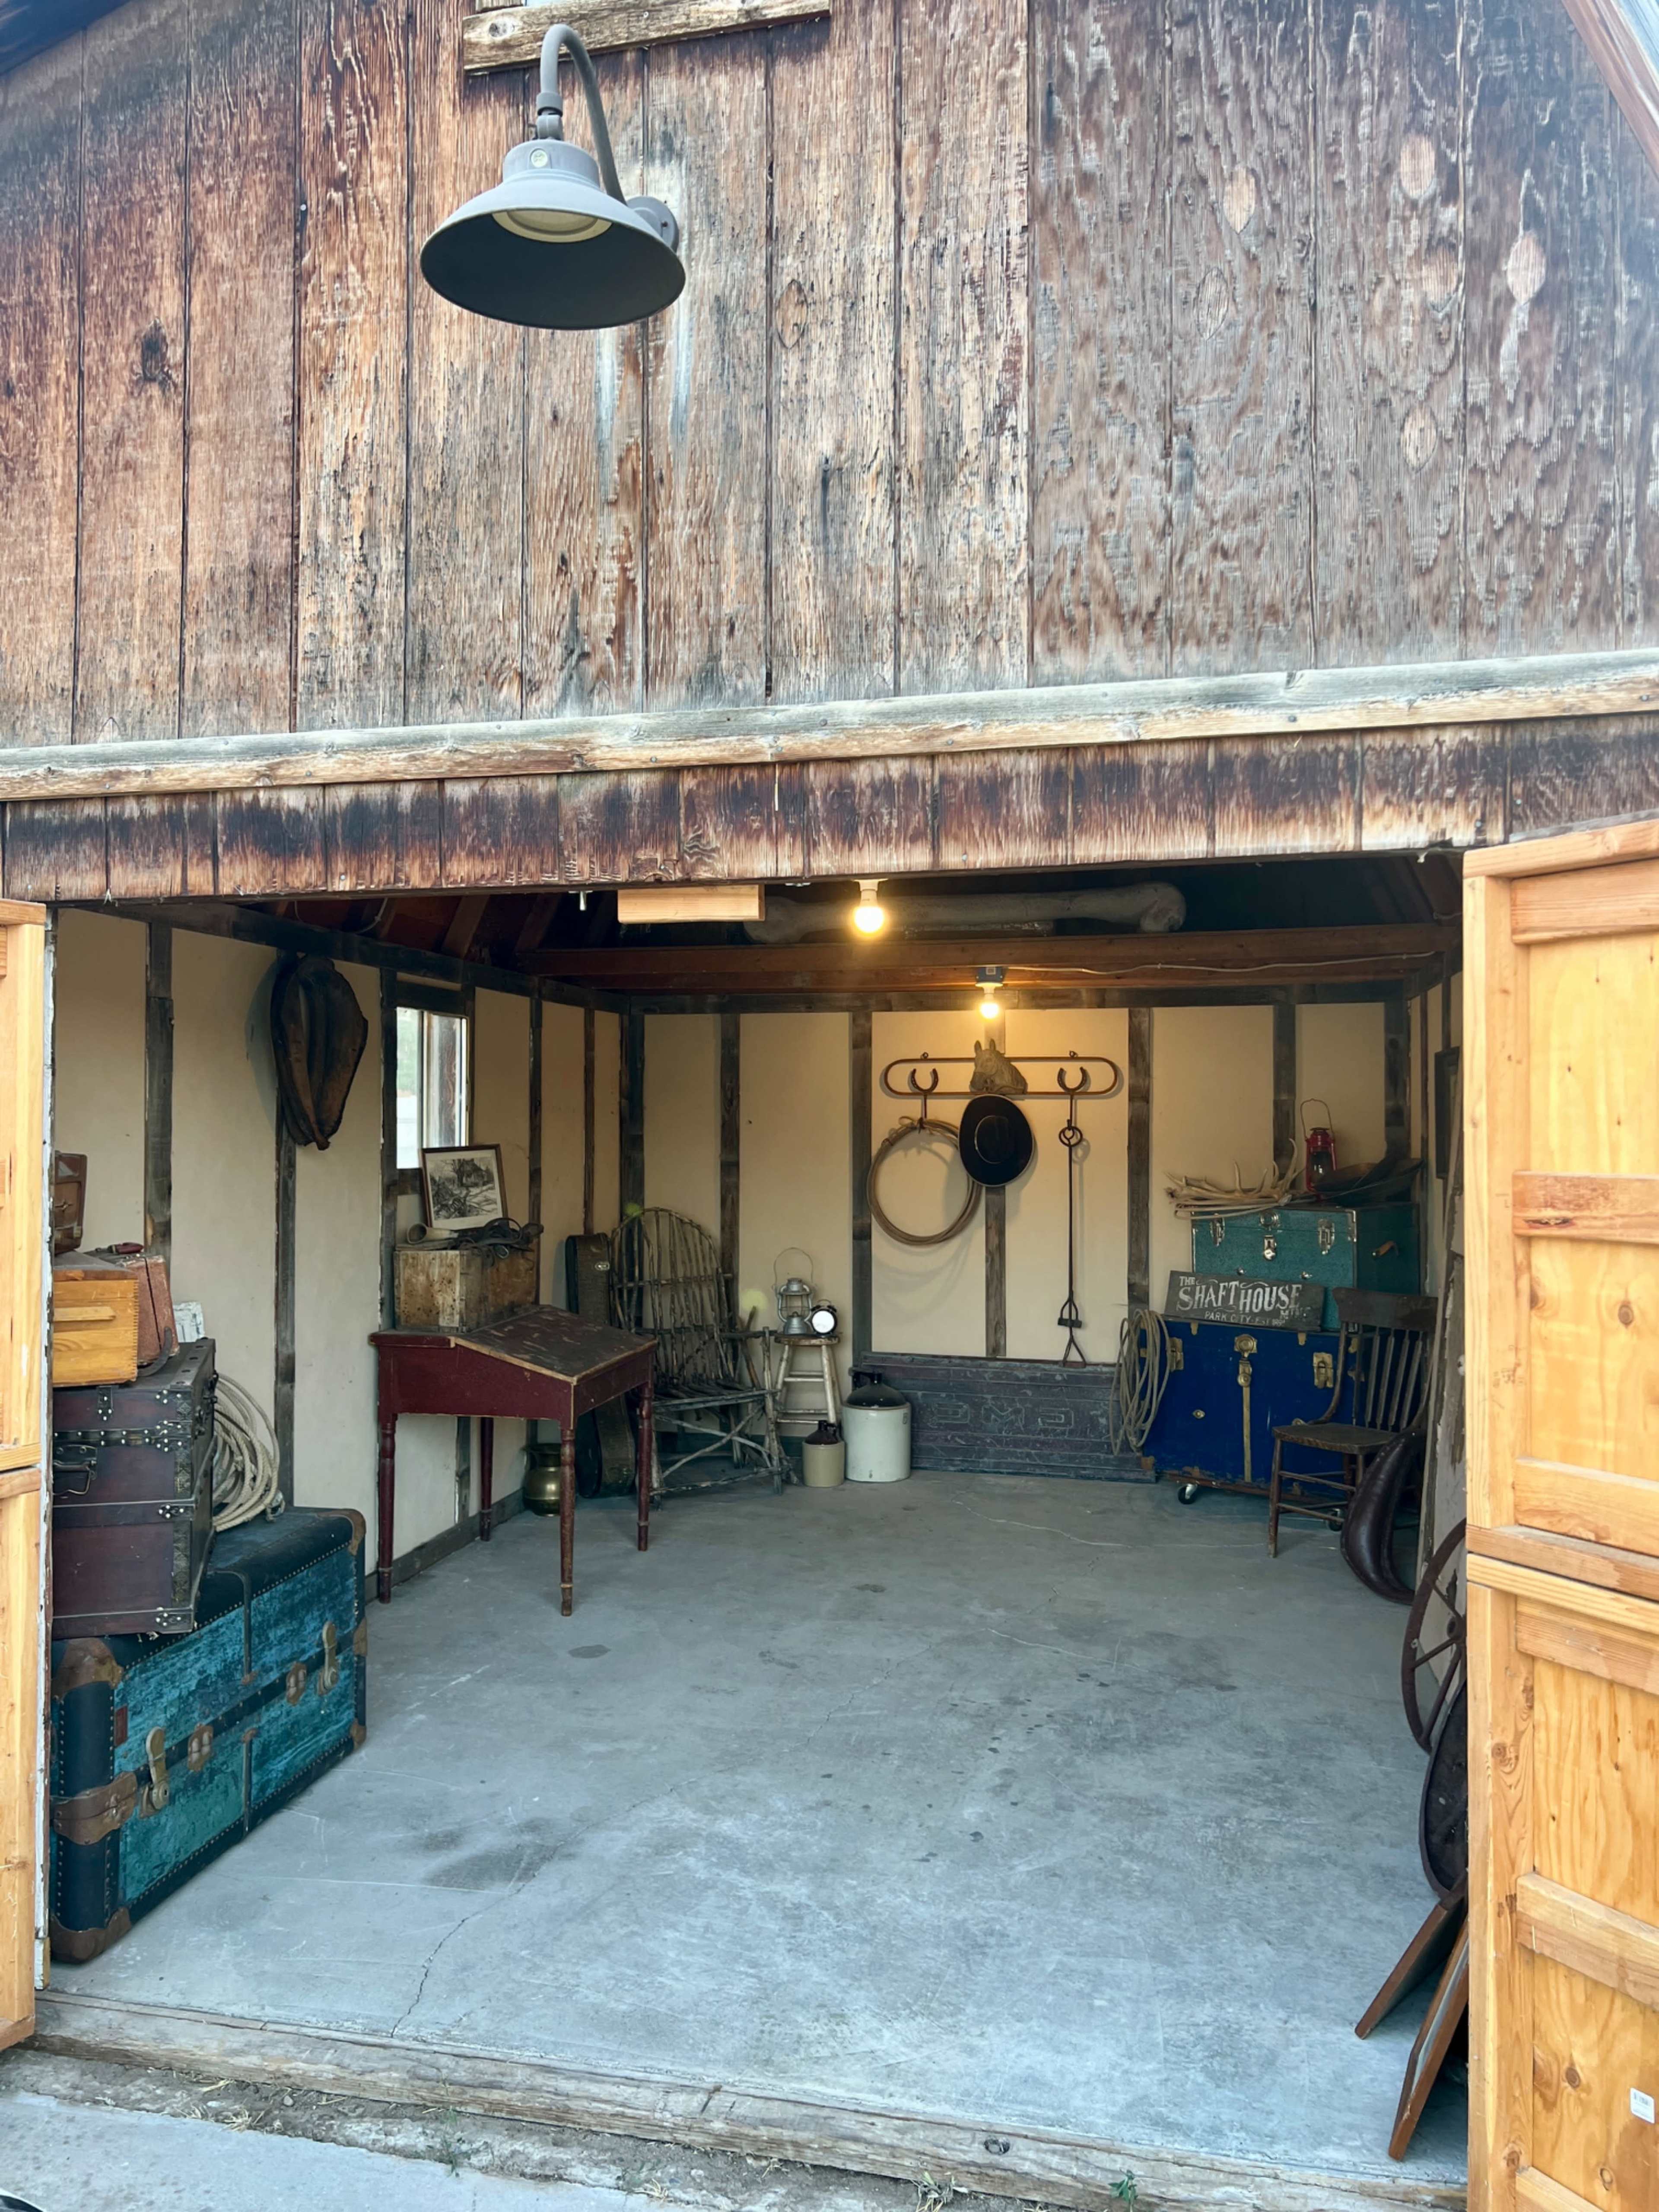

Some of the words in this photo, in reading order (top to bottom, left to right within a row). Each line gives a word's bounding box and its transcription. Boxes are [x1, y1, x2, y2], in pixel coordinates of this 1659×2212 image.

[1179, 1276, 1195, 1287] THE
[1176, 1281, 1239, 1311] SHAFT
[1239, 1284, 1302, 1313] HOUSE
[1205, 1311, 1227, 1321] PARK
[1230, 1314, 1251, 1324] CTY
